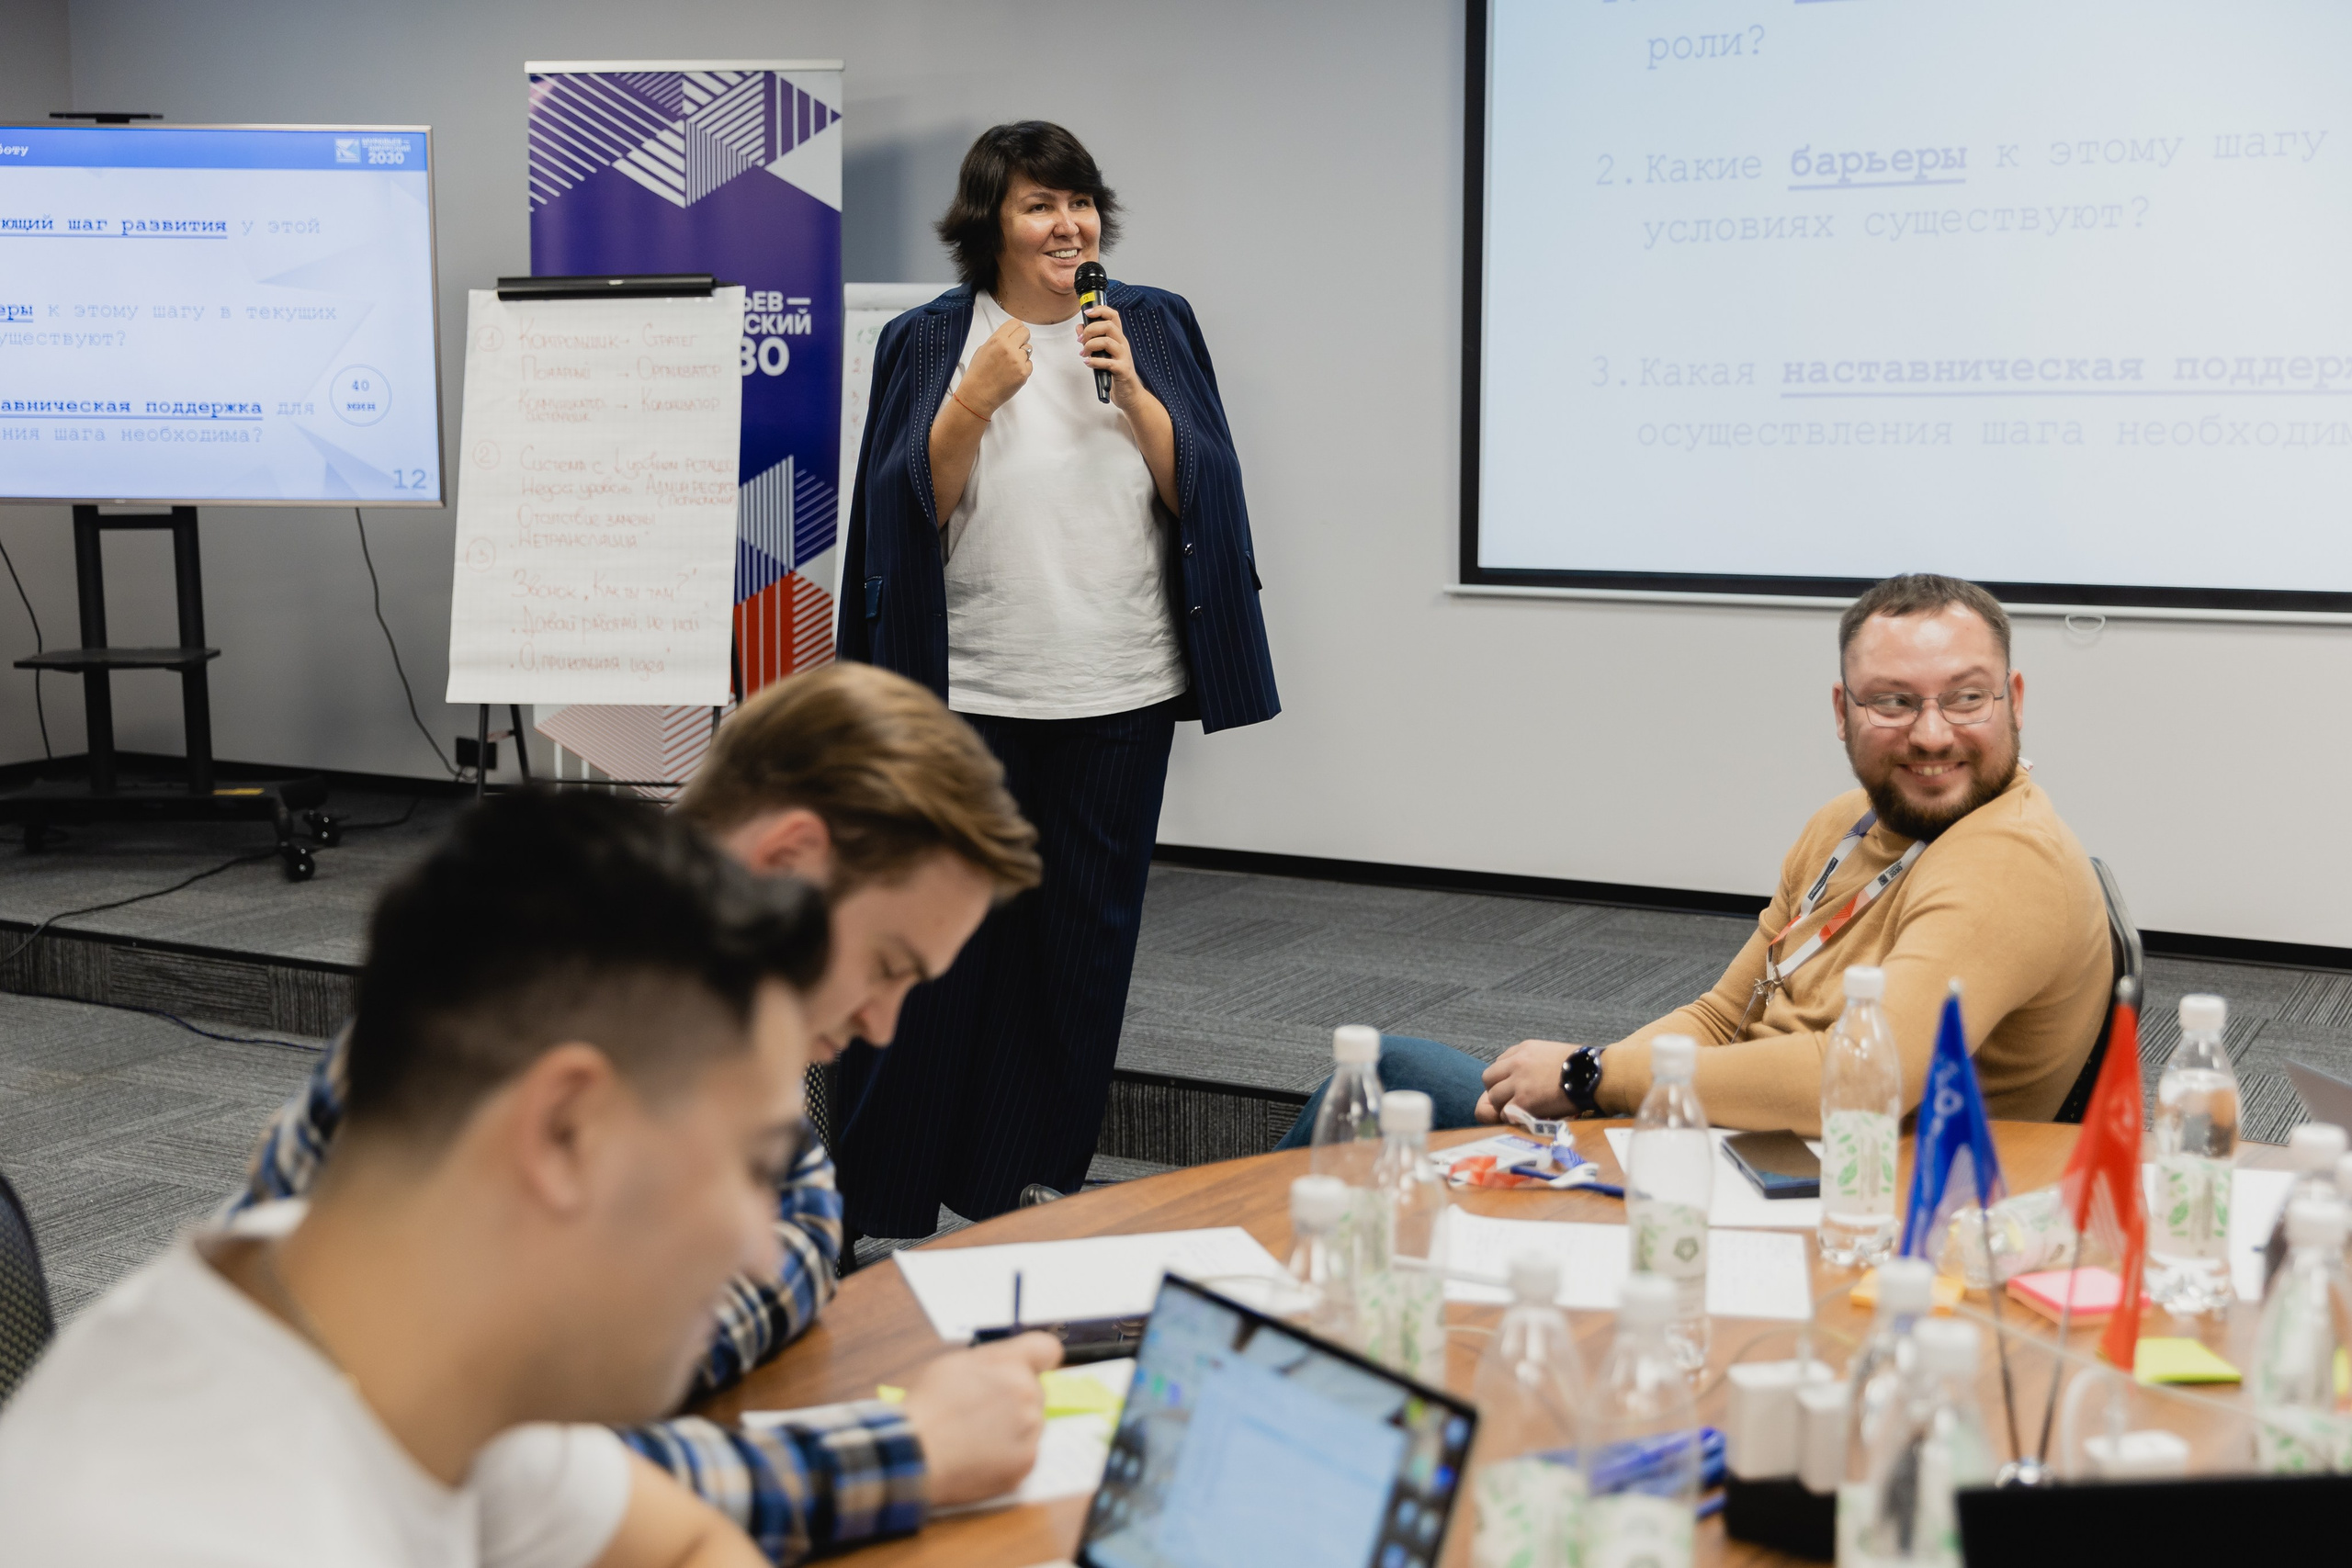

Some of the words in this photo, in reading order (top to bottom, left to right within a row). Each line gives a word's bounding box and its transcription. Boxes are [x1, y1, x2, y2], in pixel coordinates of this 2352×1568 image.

[1645, 24, 1766, 71] роли?
[368, 152, 404, 164] 2030
[1790, 141, 1968, 186] барьеры
[1996, 142, 2020, 169] к
[2049, 135, 2185, 169] этому
[2212, 129, 2330, 164] шагу
[68, 219, 107, 231] шаг
[121, 219, 228, 235] развития
[242, 220, 254, 236] у
[267, 214, 321, 234] этой
[1643, 211, 1836, 251] условиях
[1863, 194, 2151, 243] существуют?
[48, 304, 60, 317] к
[74, 304, 138, 321] этому
[153, 305, 204, 321] шагу
[220, 306, 232, 320] в
[246, 306, 337, 322] текущих
[1781, 356, 2145, 385] наставническая
[2173, 355, 2352, 391] поддер
[352, 379, 370, 391] 40
[145, 400, 263, 418] поддержка
[277, 401, 315, 416] для
[54, 427, 106, 442] шага
[121, 426, 264, 443] необходима?
[1637, 420, 1953, 453] осуществления
[1983, 420, 2085, 446] шага
[393, 468, 427, 490] 12
